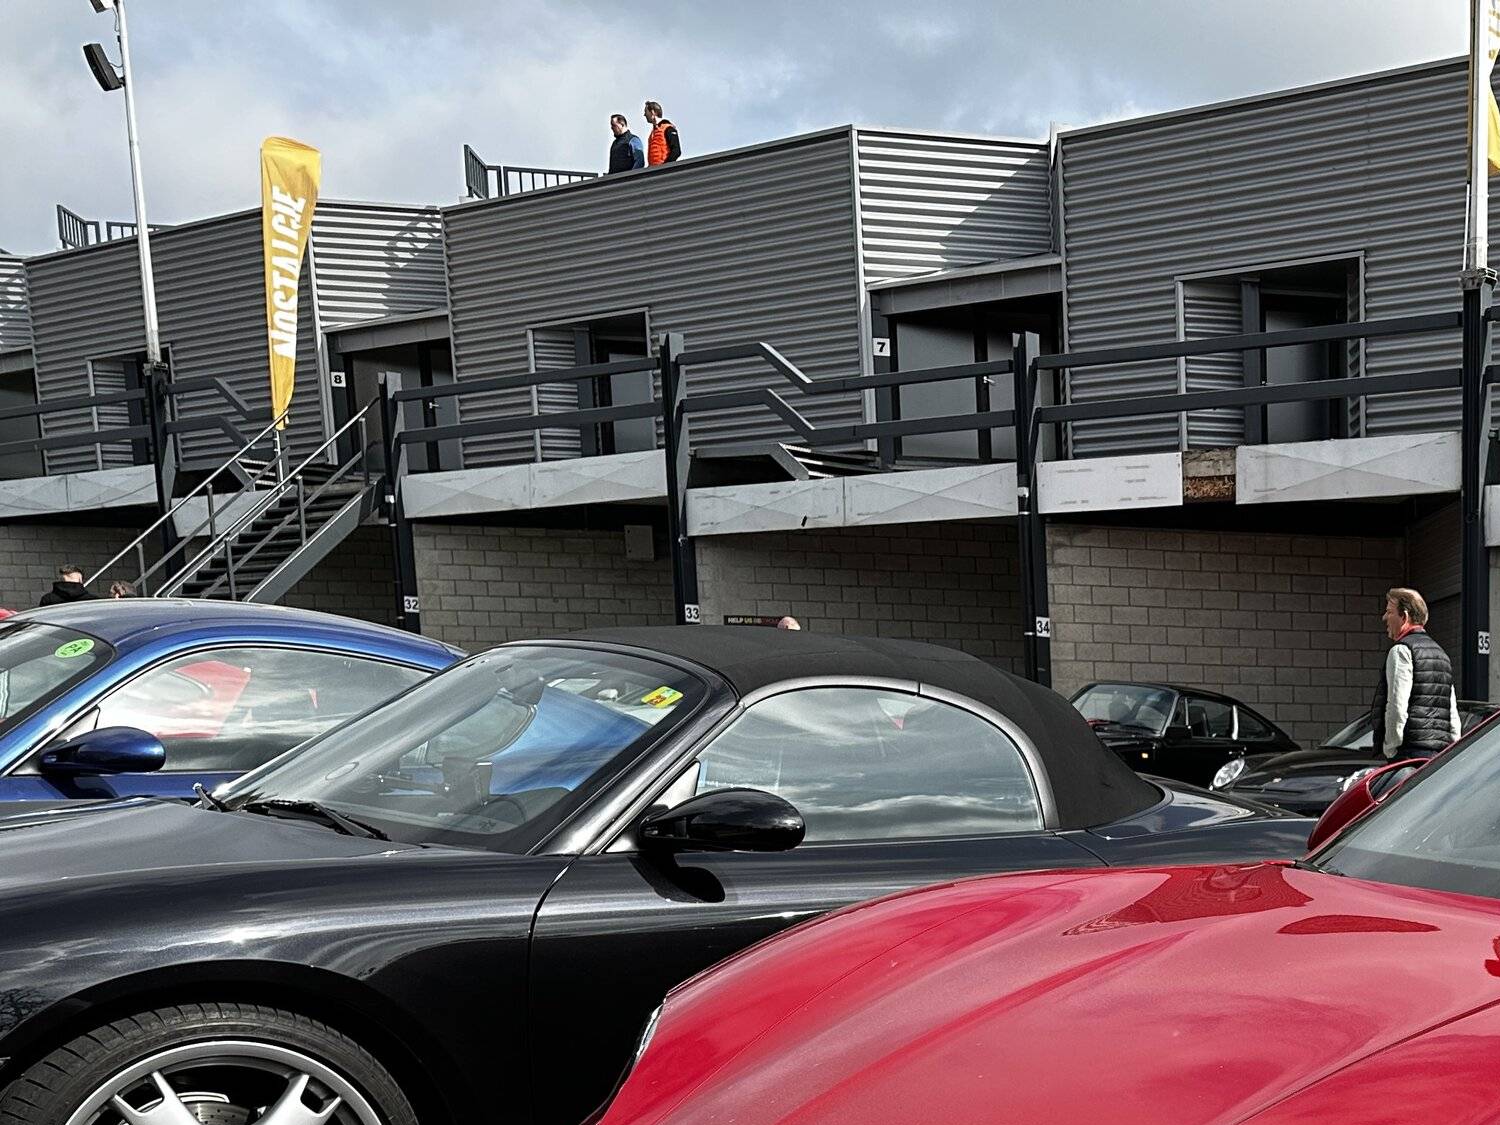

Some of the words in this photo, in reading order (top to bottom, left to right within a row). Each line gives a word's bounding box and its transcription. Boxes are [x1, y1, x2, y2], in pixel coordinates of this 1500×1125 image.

[877, 341, 886, 353] 7
[334, 375, 342, 384] 8
[405, 599, 418, 609] 32
[686, 607, 699, 620] 33
[1037, 621, 1050, 634] 34
[1480, 635, 1490, 650] 35
